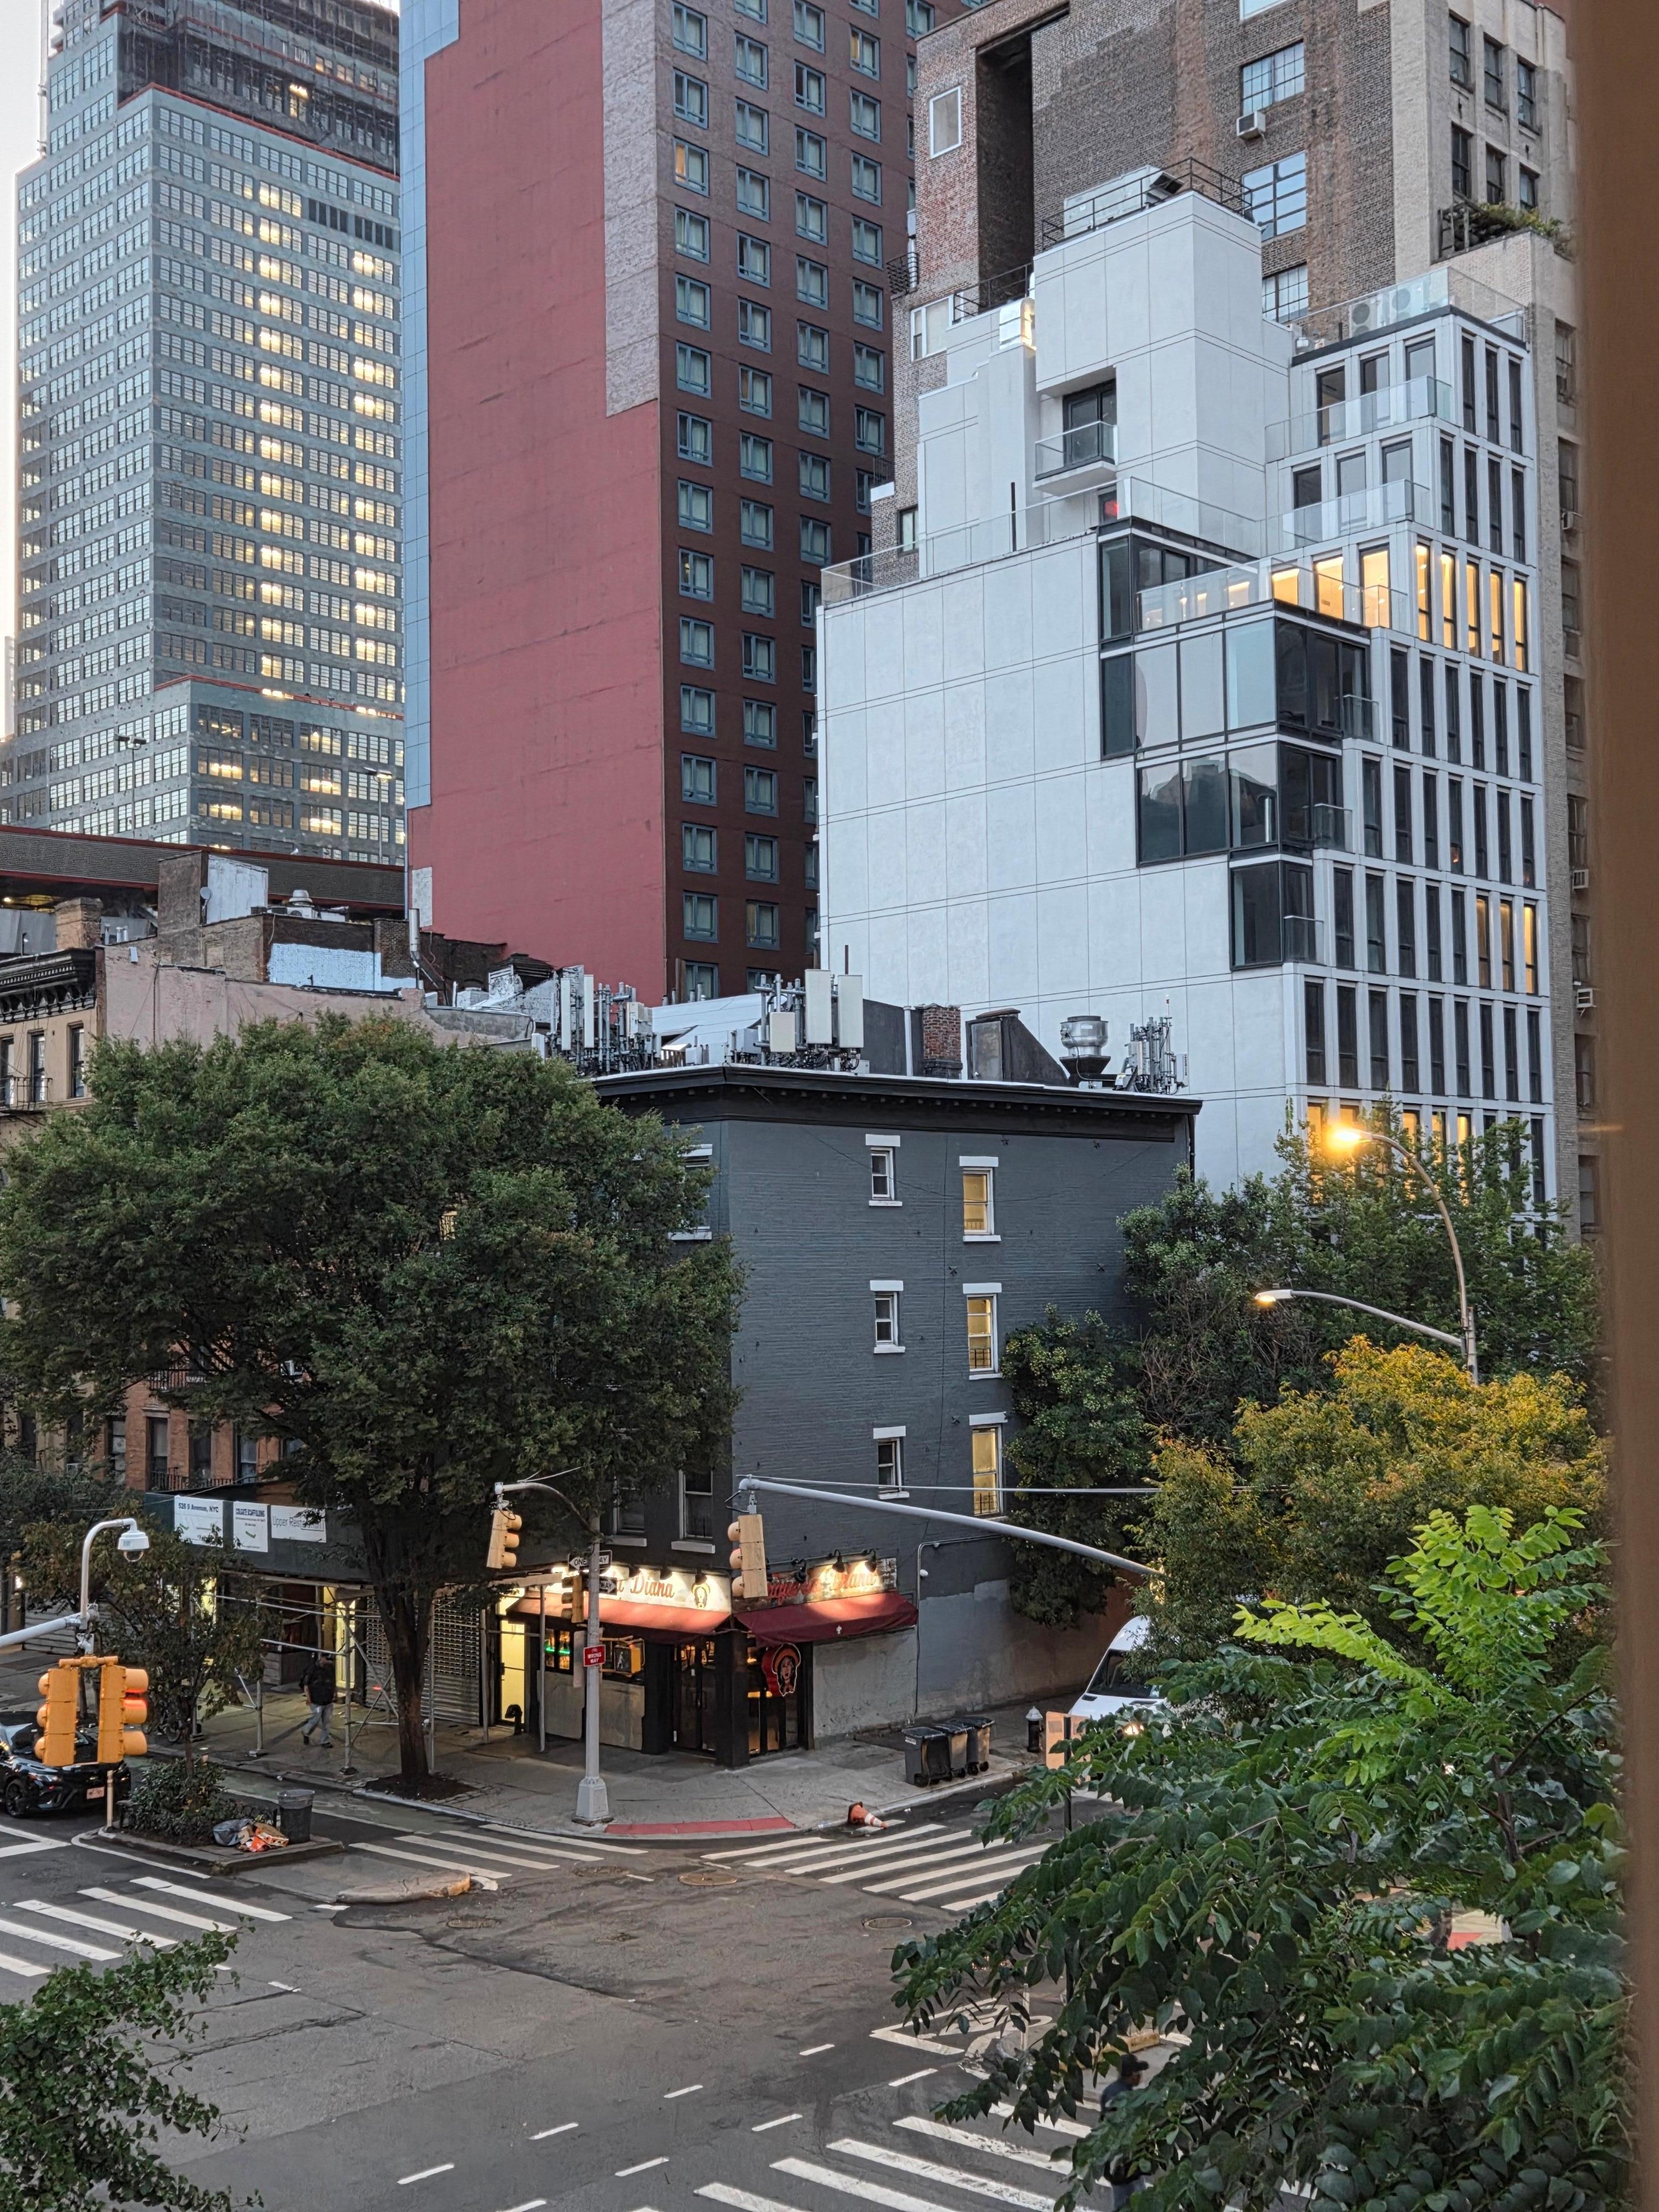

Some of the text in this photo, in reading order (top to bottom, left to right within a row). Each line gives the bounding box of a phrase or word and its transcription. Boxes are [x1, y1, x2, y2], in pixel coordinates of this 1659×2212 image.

[273, 1515, 288, 1527] Upper
[574, 1557, 587, 1566] ONE
[630, 1572, 675, 1598] Diana
